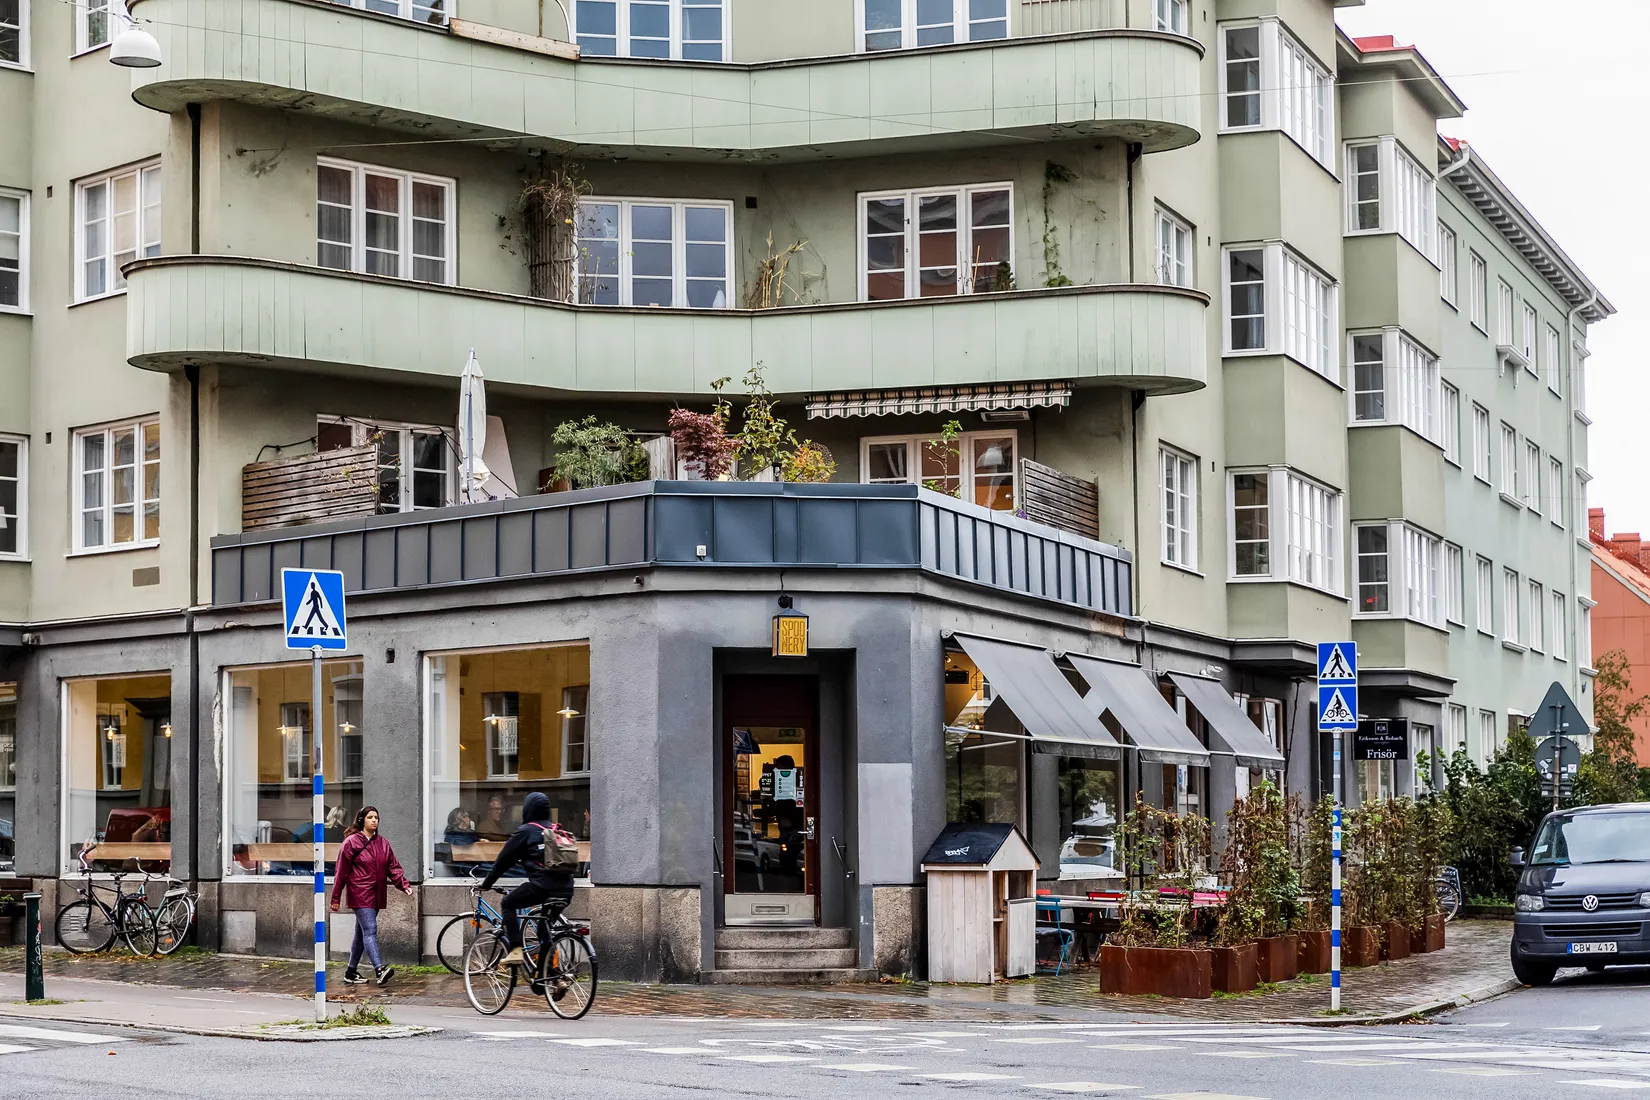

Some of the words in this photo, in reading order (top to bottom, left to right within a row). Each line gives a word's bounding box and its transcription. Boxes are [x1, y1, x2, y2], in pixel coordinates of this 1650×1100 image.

[782, 621, 805, 636] SPOO
[782, 636, 805, 653] NERY
[1367, 749, 1397, 759] Frisör
[1573, 943, 1591, 952] CBW
[1597, 942, 1615, 952] 412
